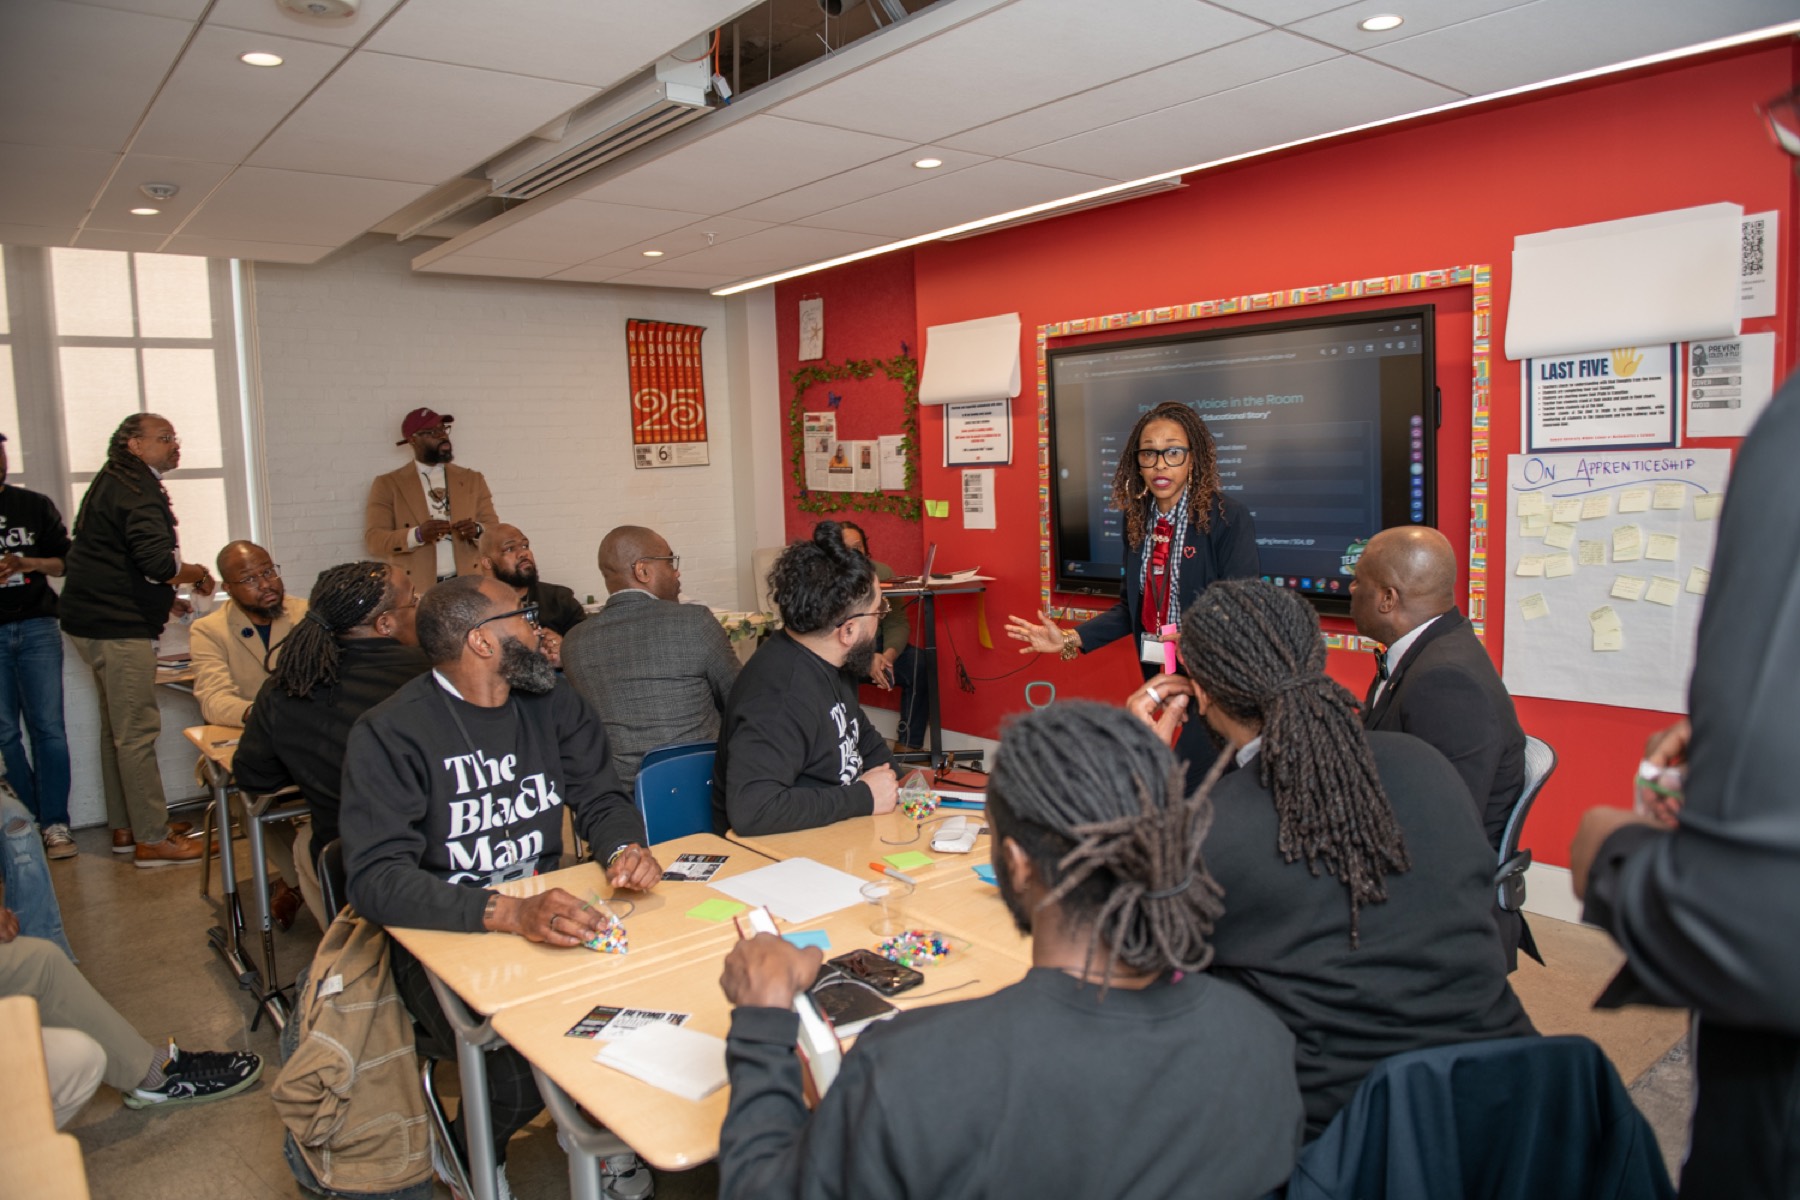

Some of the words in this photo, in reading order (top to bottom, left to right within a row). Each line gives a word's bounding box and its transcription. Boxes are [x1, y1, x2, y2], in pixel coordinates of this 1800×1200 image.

[629, 330, 698, 342] NATIONAL
[648, 343, 682, 355] BOOK
[1708, 343, 1740, 353] PREVENT
[631, 355, 700, 367] FESTIVAL
[1541, 361, 1574, 380] LAST
[1579, 358, 1608, 378] FIVE
[634, 388, 703, 430] 25
[1198, 398, 1228, 409] Voice
[1230, 397, 1241, 407] in
[1243, 396, 1265, 406] the
[1267, 394, 1304, 405] Room
[659, 445, 668, 461] 6
[1523, 457, 1556, 484] ON
[1576, 458, 1696, 487] APPRENTICESHIP
[444, 749, 517, 795] The
[447, 773, 562, 839] Black
[445, 829, 543, 871] Man
